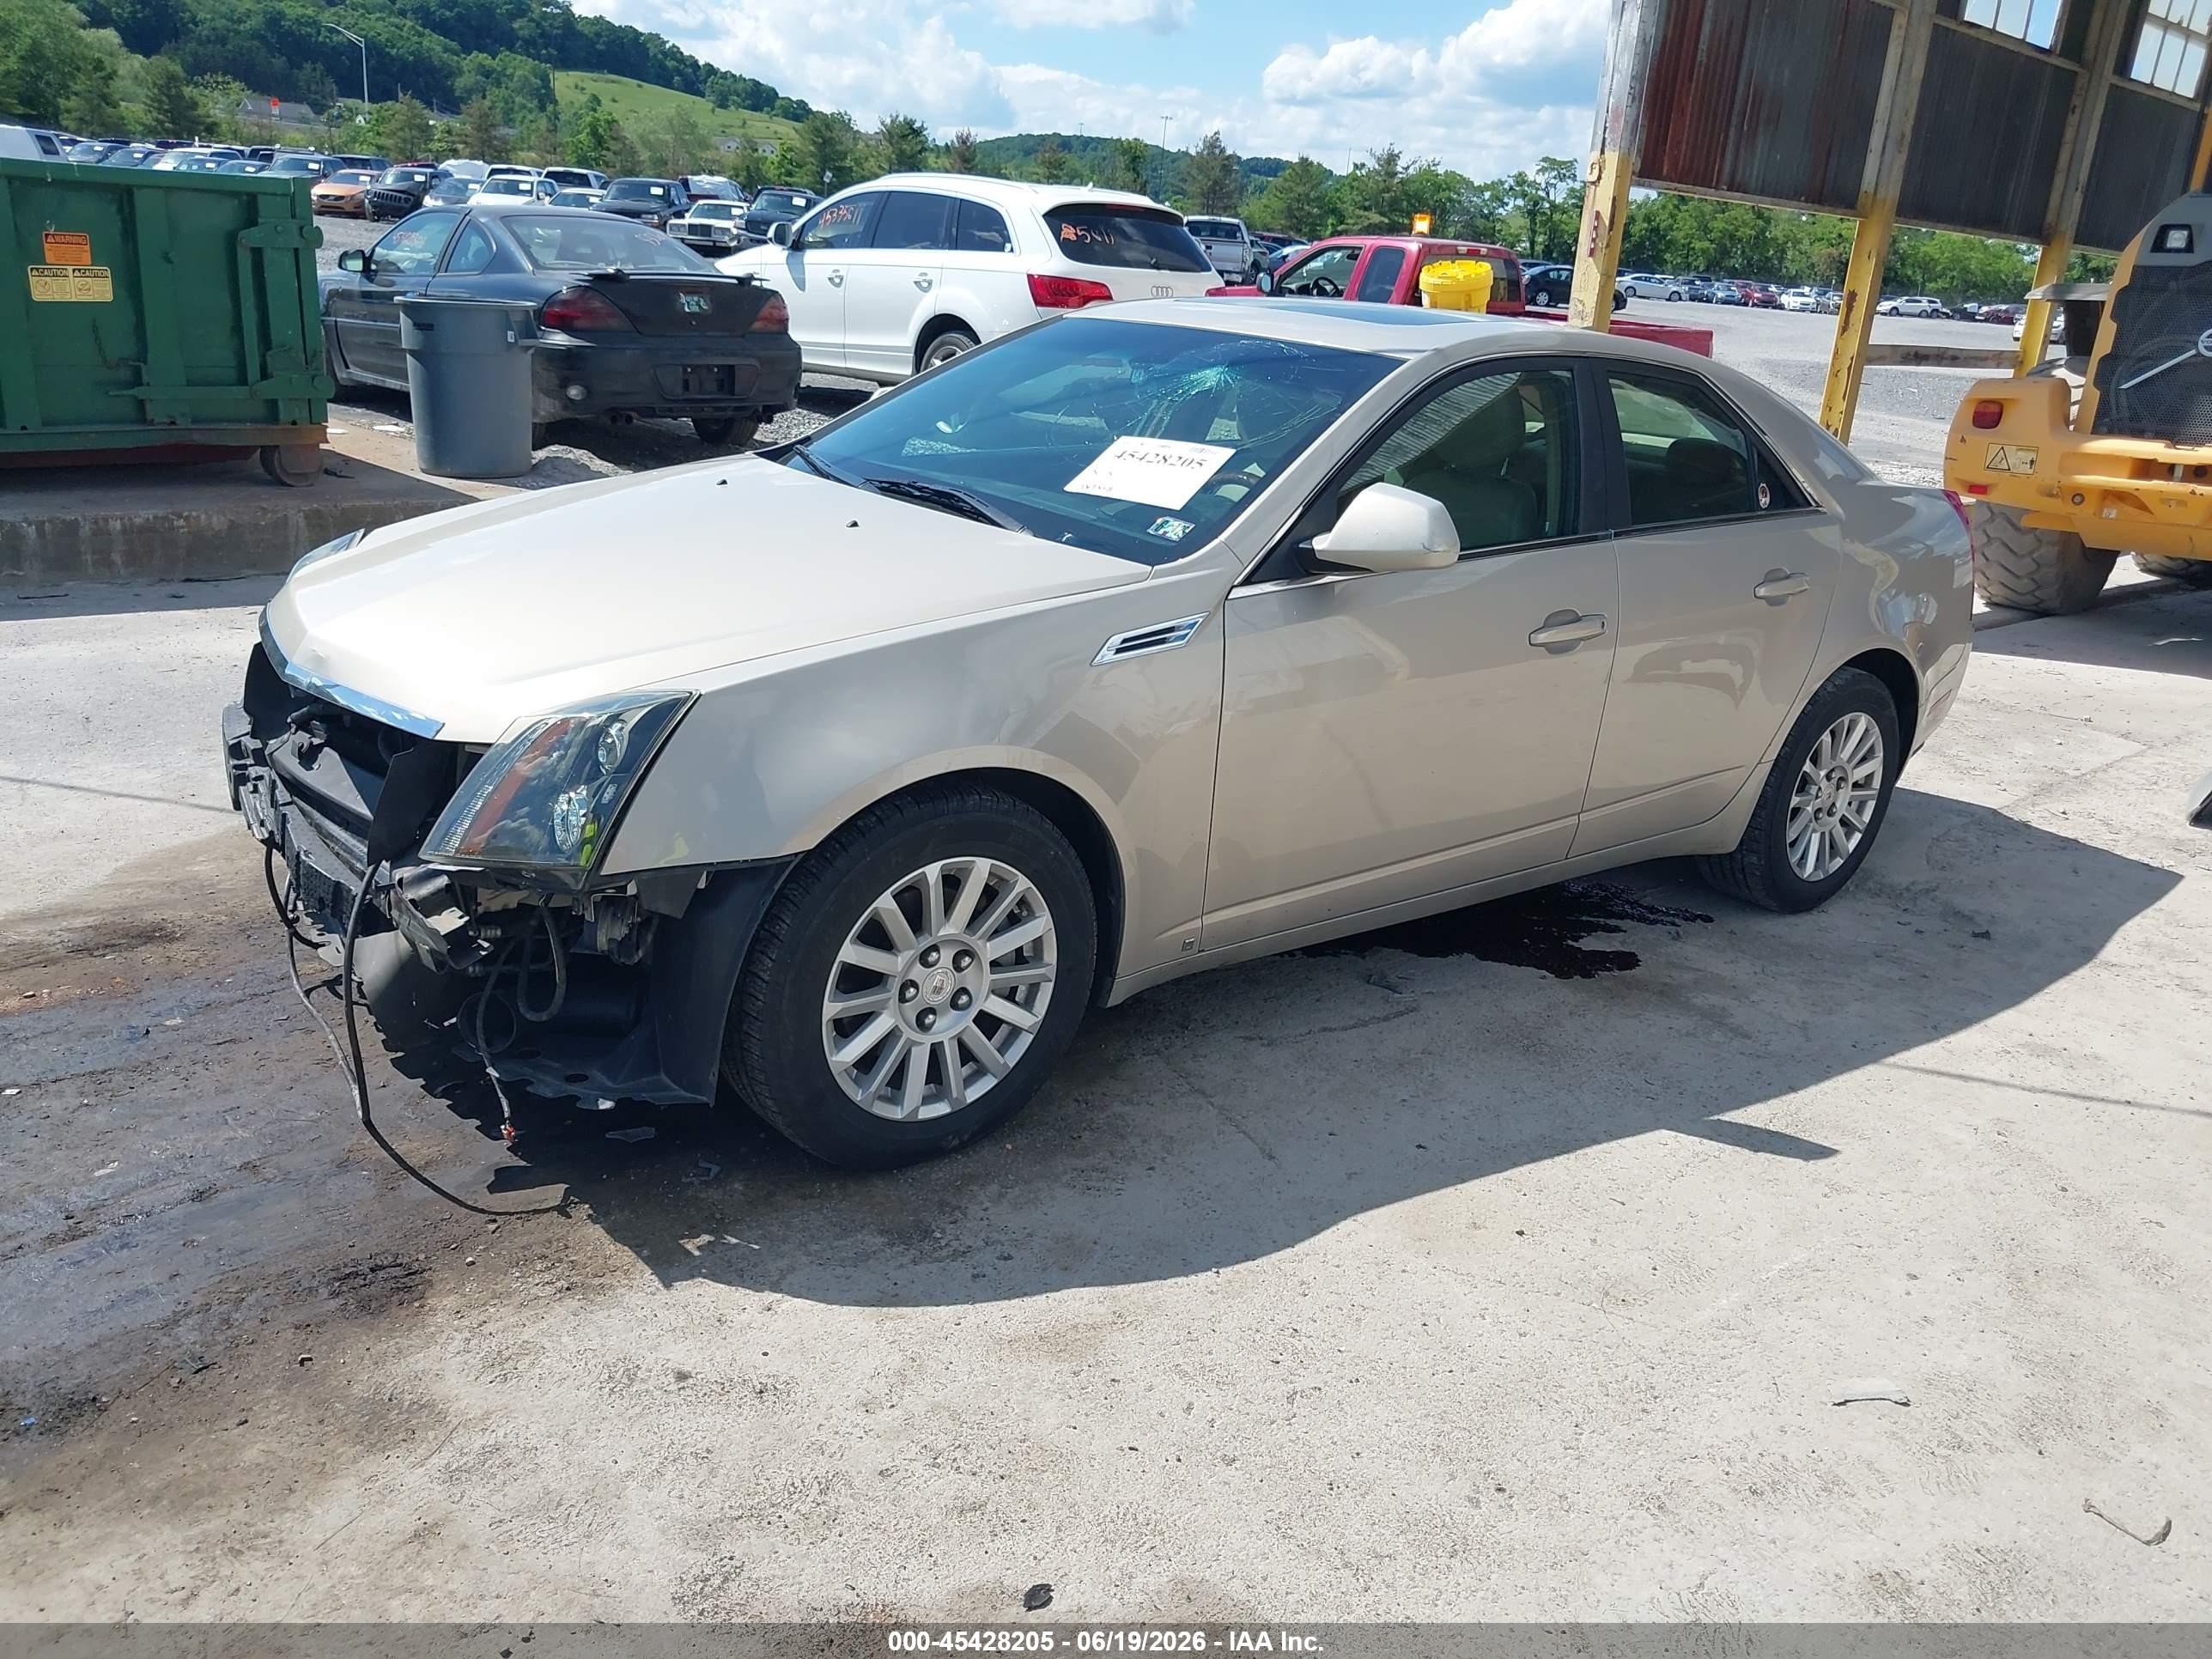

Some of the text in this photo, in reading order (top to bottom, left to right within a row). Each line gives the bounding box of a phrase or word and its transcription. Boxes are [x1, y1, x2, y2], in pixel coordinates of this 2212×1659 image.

[54, 235, 88, 245] WARNING
[38, 268, 69, 276] CAUTION
[80, 269, 109, 277] CAUTION
[1114, 449, 1210, 471] 45428205
